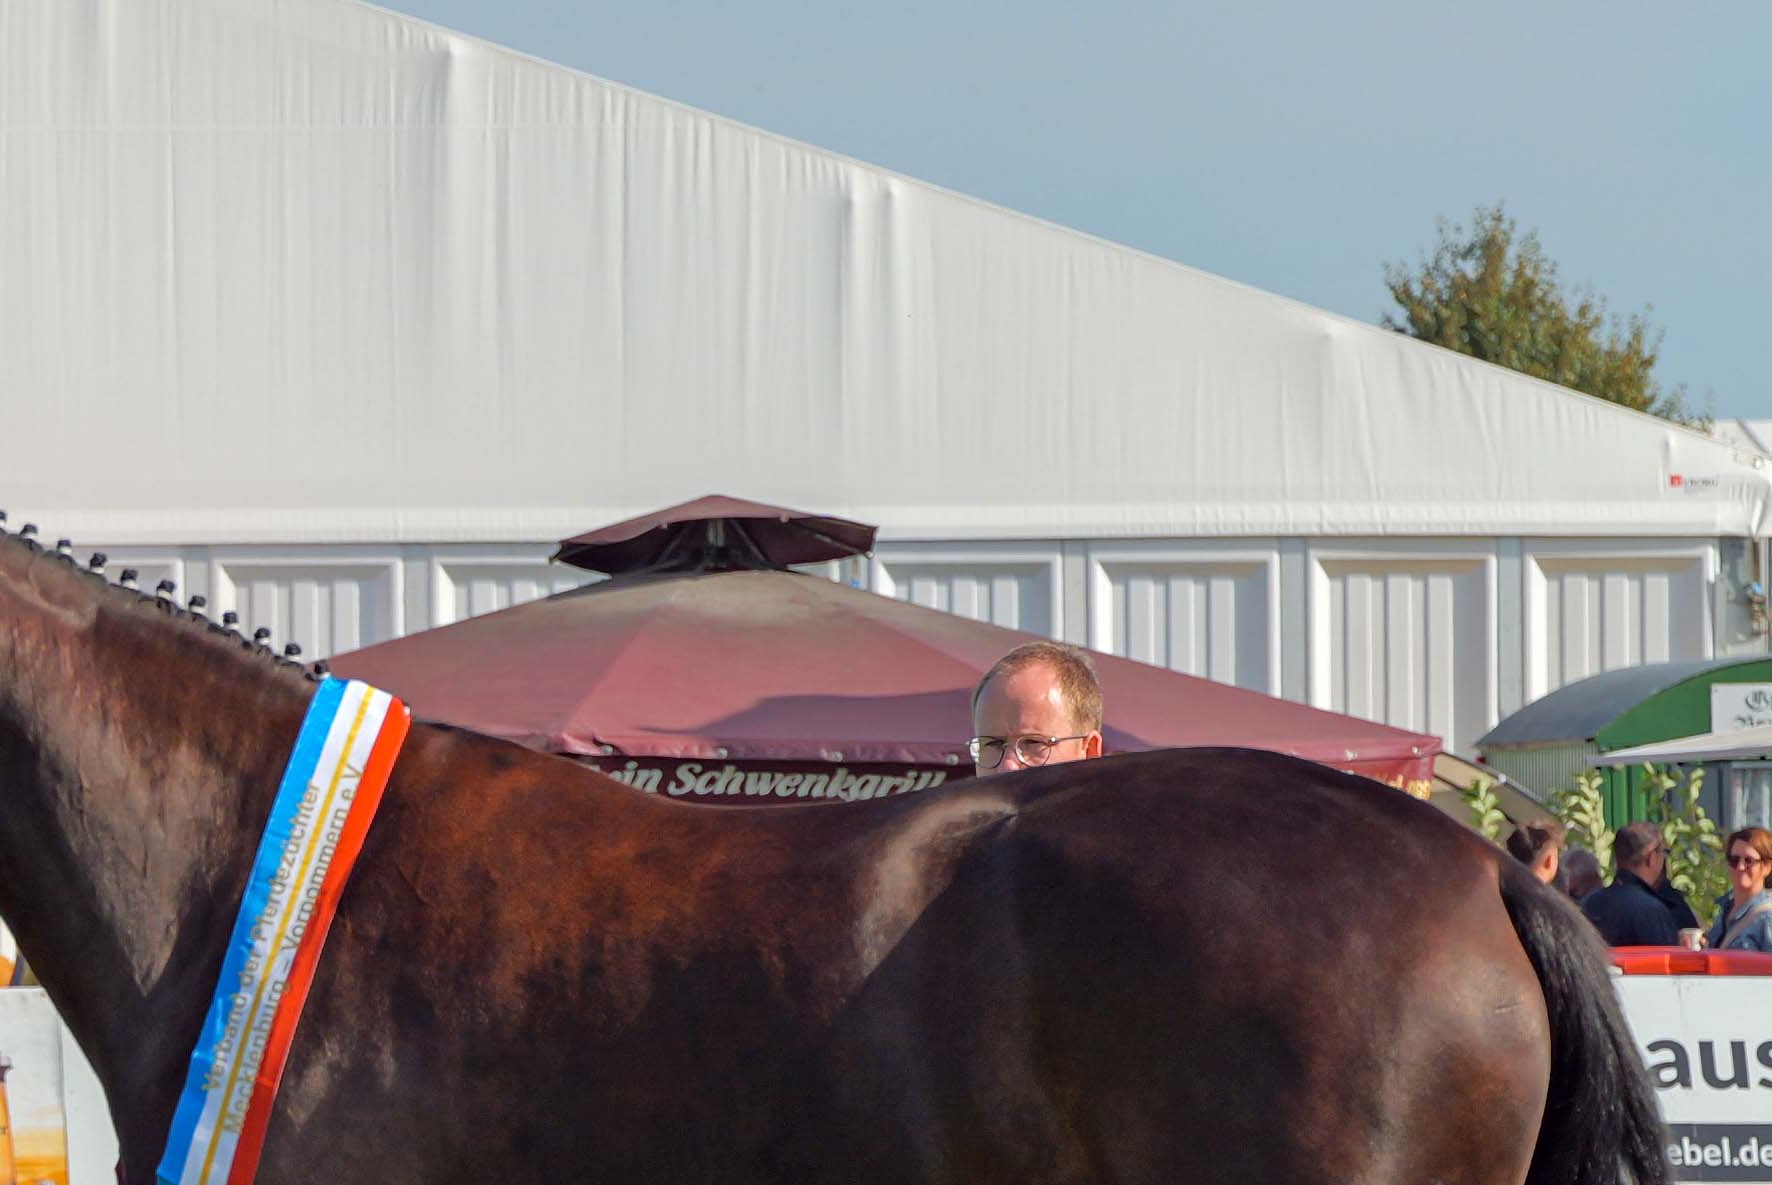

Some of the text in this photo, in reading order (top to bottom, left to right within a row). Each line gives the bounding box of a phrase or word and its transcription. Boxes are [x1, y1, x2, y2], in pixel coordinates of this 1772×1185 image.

[201, 779, 320, 1090] Verband der Pferdezüchter
[668, 763, 947, 802] Schwenkgrill
[223, 980, 291, 1133] Mecklenburg
[281, 807, 348, 951] Vorpommern
